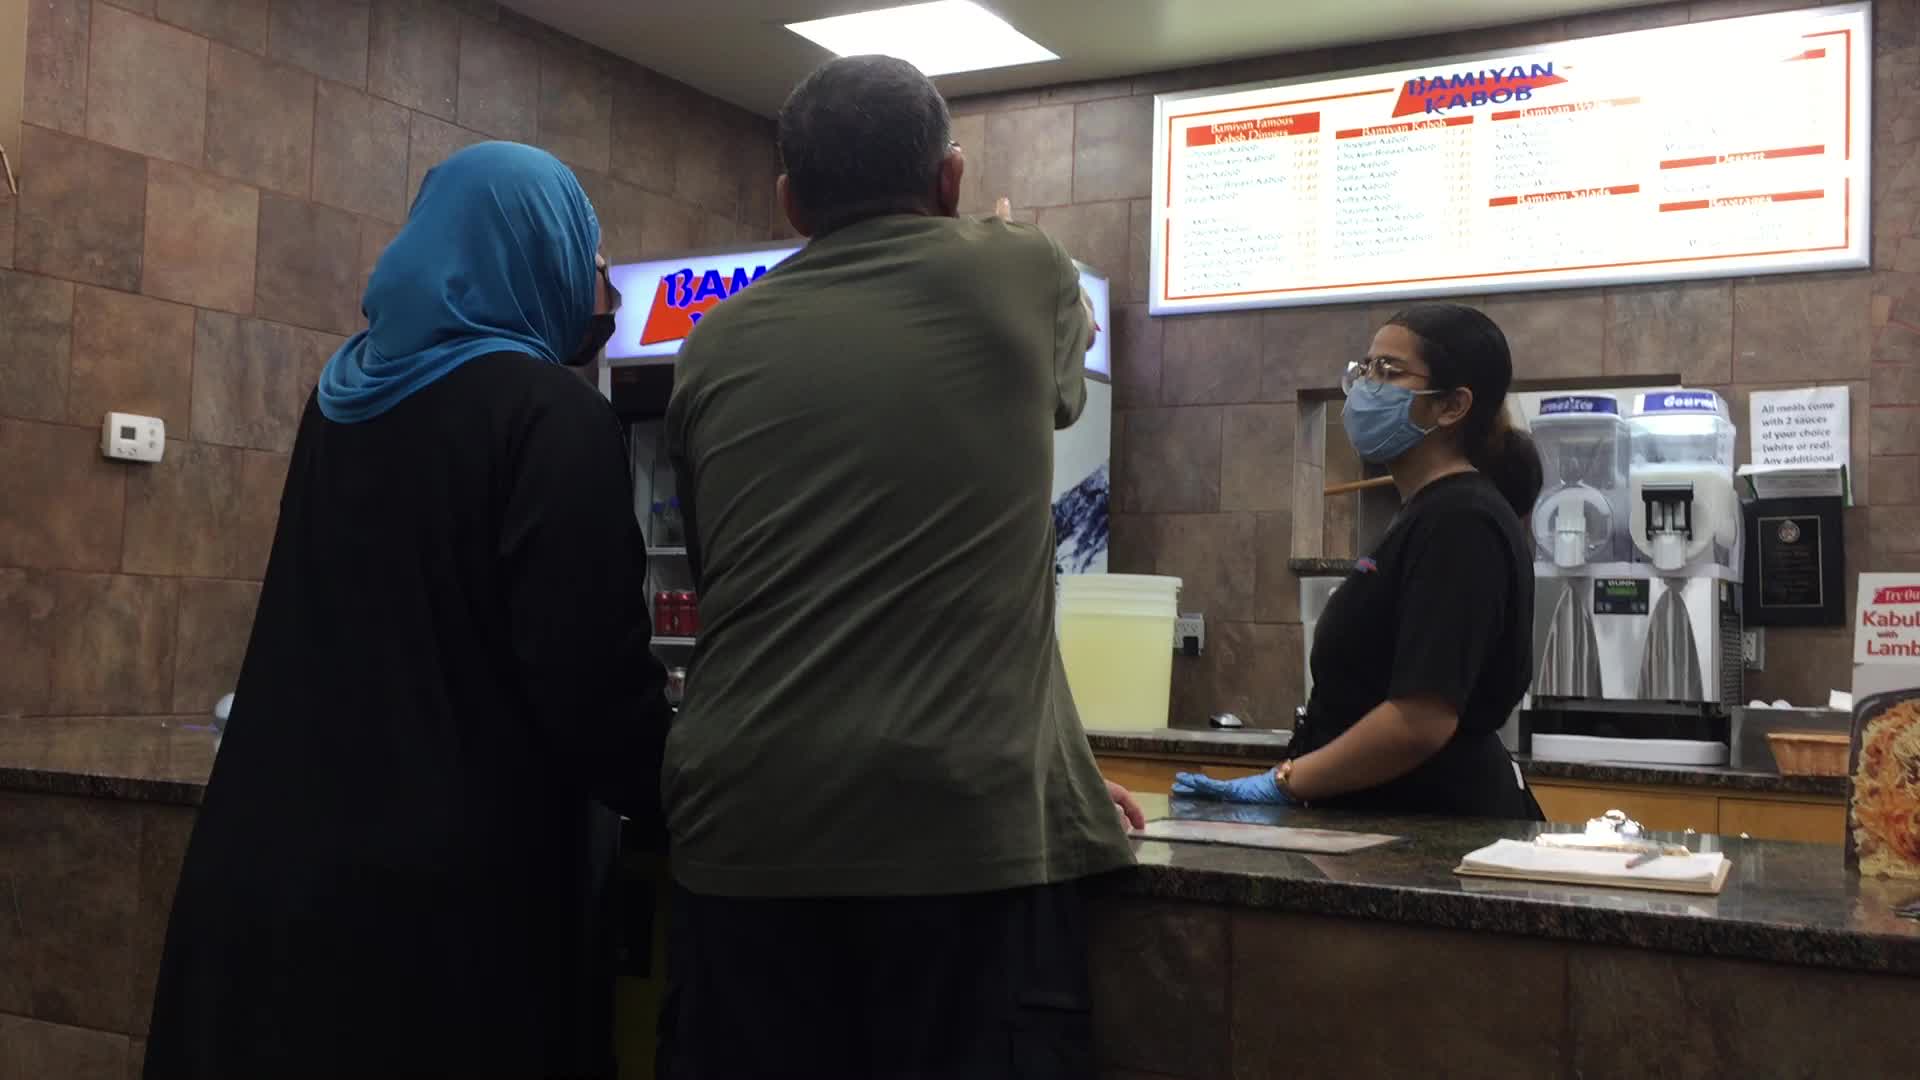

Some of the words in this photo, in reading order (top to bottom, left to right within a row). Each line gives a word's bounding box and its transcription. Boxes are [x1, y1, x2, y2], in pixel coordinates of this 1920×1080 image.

[1407, 62, 1554, 96] BAMIYAN
[1424, 83, 1533, 115] KABOB
[1211, 120, 1254, 134] Bamiyan
[1256, 116, 1294, 128] Famous
[1362, 123, 1409, 137] Bamiyan
[1412, 119, 1447, 131] Kabob
[1215, 132, 1247, 145] Kabob
[1248, 128, 1289, 139] Dinners
[1761, 404, 1775, 414] All
[1776, 403, 1806, 413] meals
[1808, 401, 1835, 411] come
[1761, 416, 1784, 427] with
[1785, 416, 1792, 425] 2
[1794, 415, 1828, 425] sauces
[1762, 430, 1773, 440] of
[1774, 431, 1797, 441] your
[1799, 429, 1831, 438] choice
[1796, 443, 1806, 451] or
[1763, 456, 1782, 465] Any
[1784, 453, 1834, 465] additional
[1866, 638, 1920, 656] Lamb
